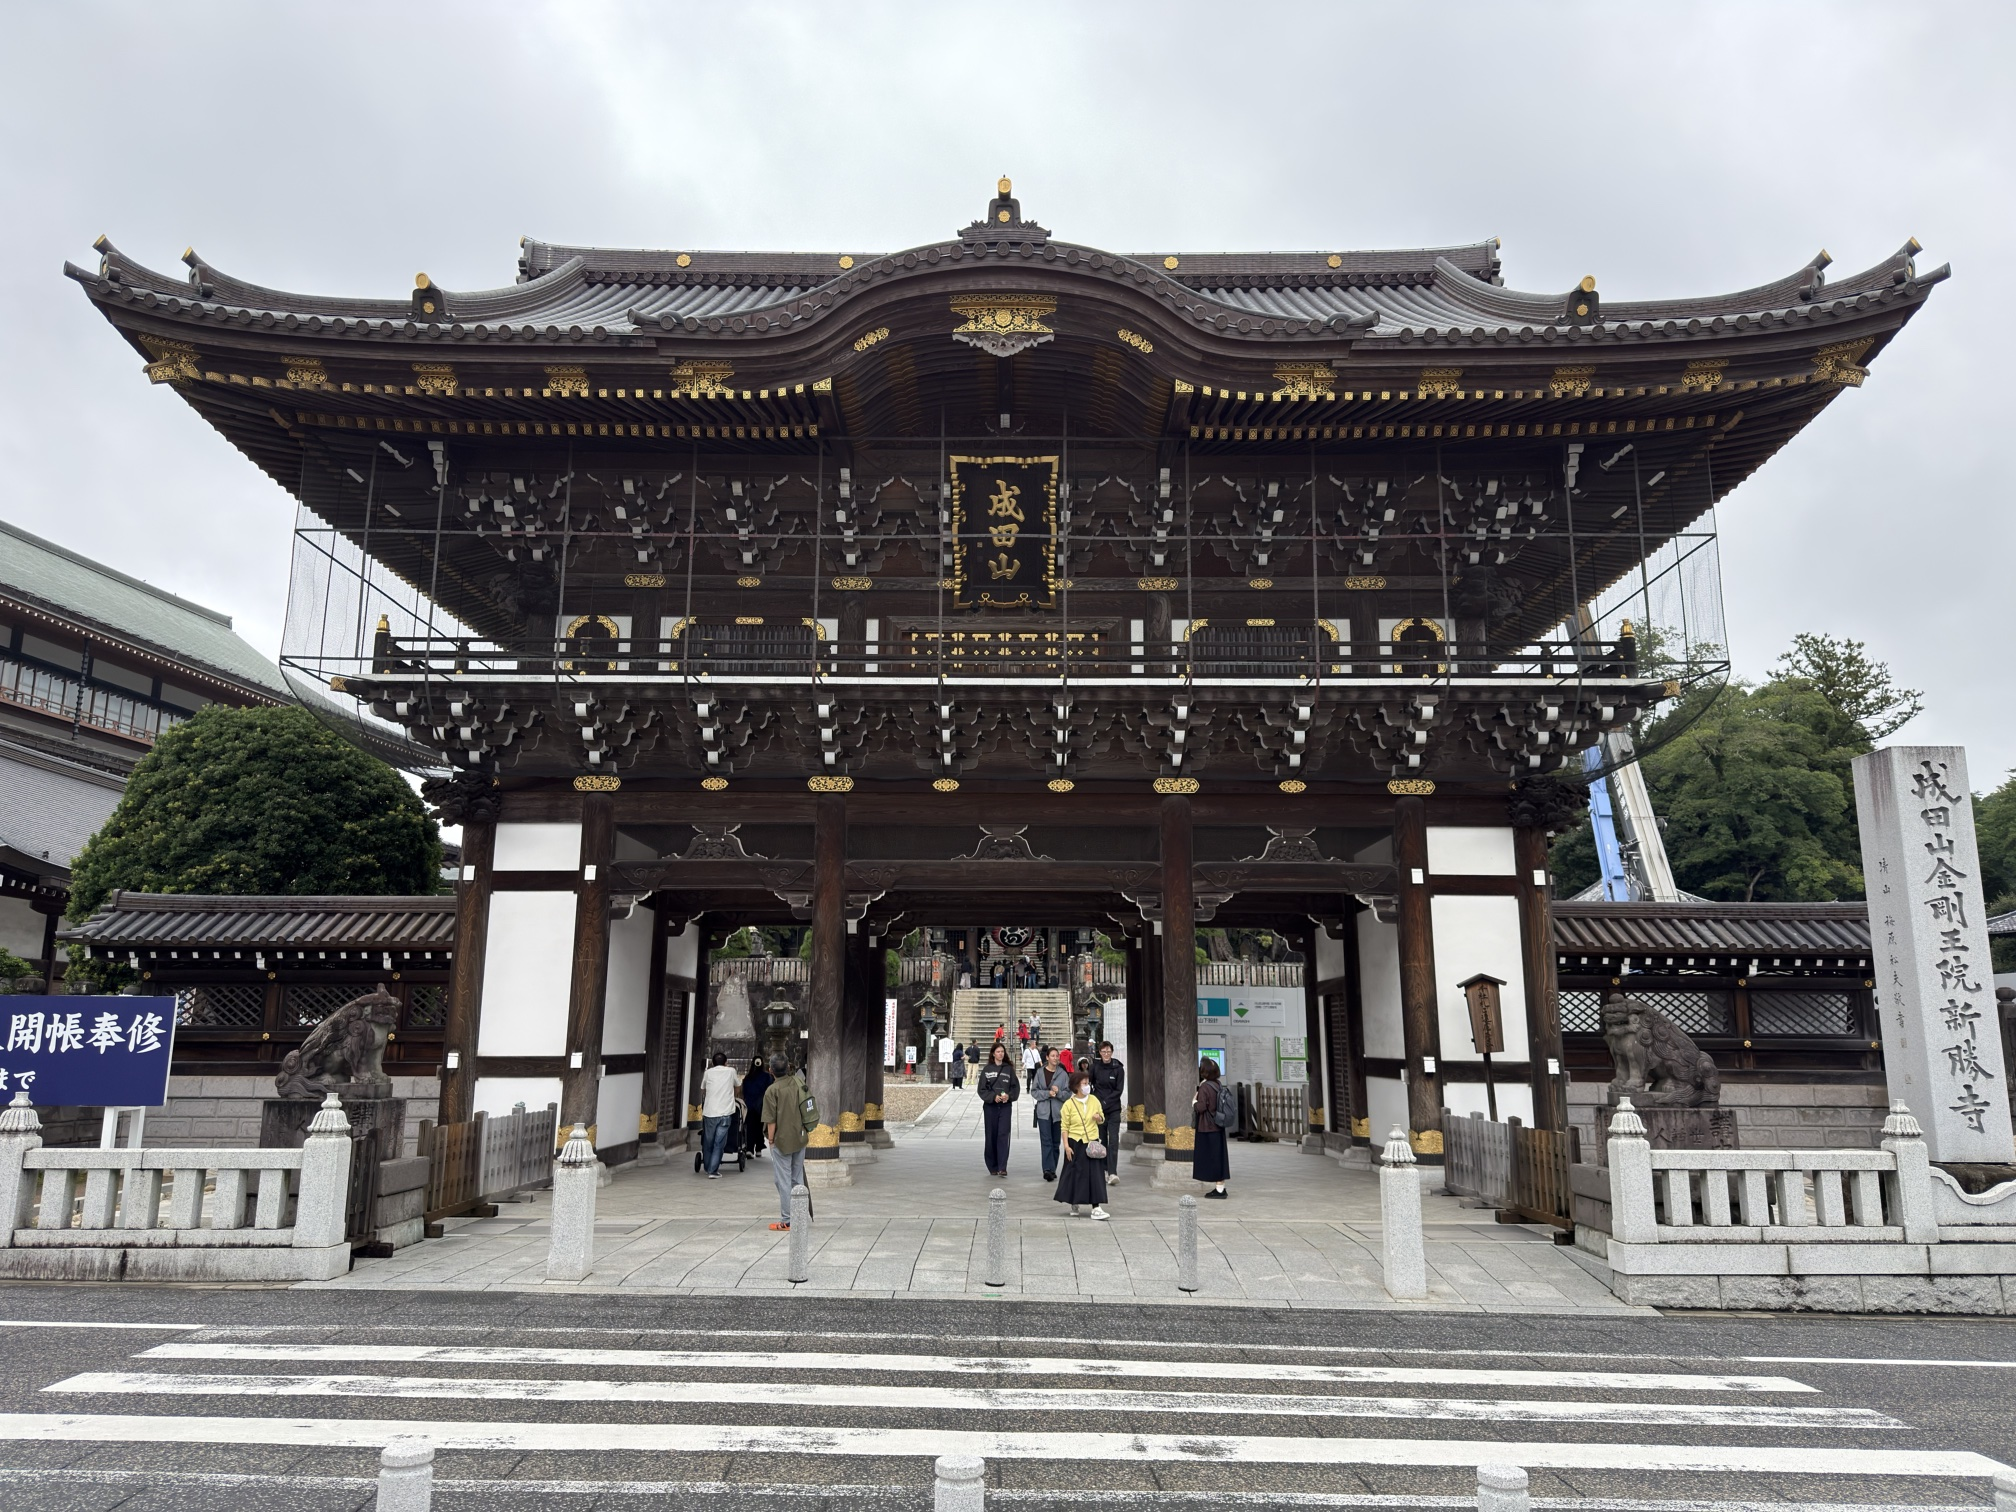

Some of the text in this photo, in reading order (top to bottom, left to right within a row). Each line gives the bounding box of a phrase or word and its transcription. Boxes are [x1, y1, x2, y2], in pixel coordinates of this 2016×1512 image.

[988, 479, 1025, 580] 成田山
[1911, 760, 1995, 1134] 成田山金剛王院新勝寺
[0, 1012, 167, 1054] 開帳奉修
